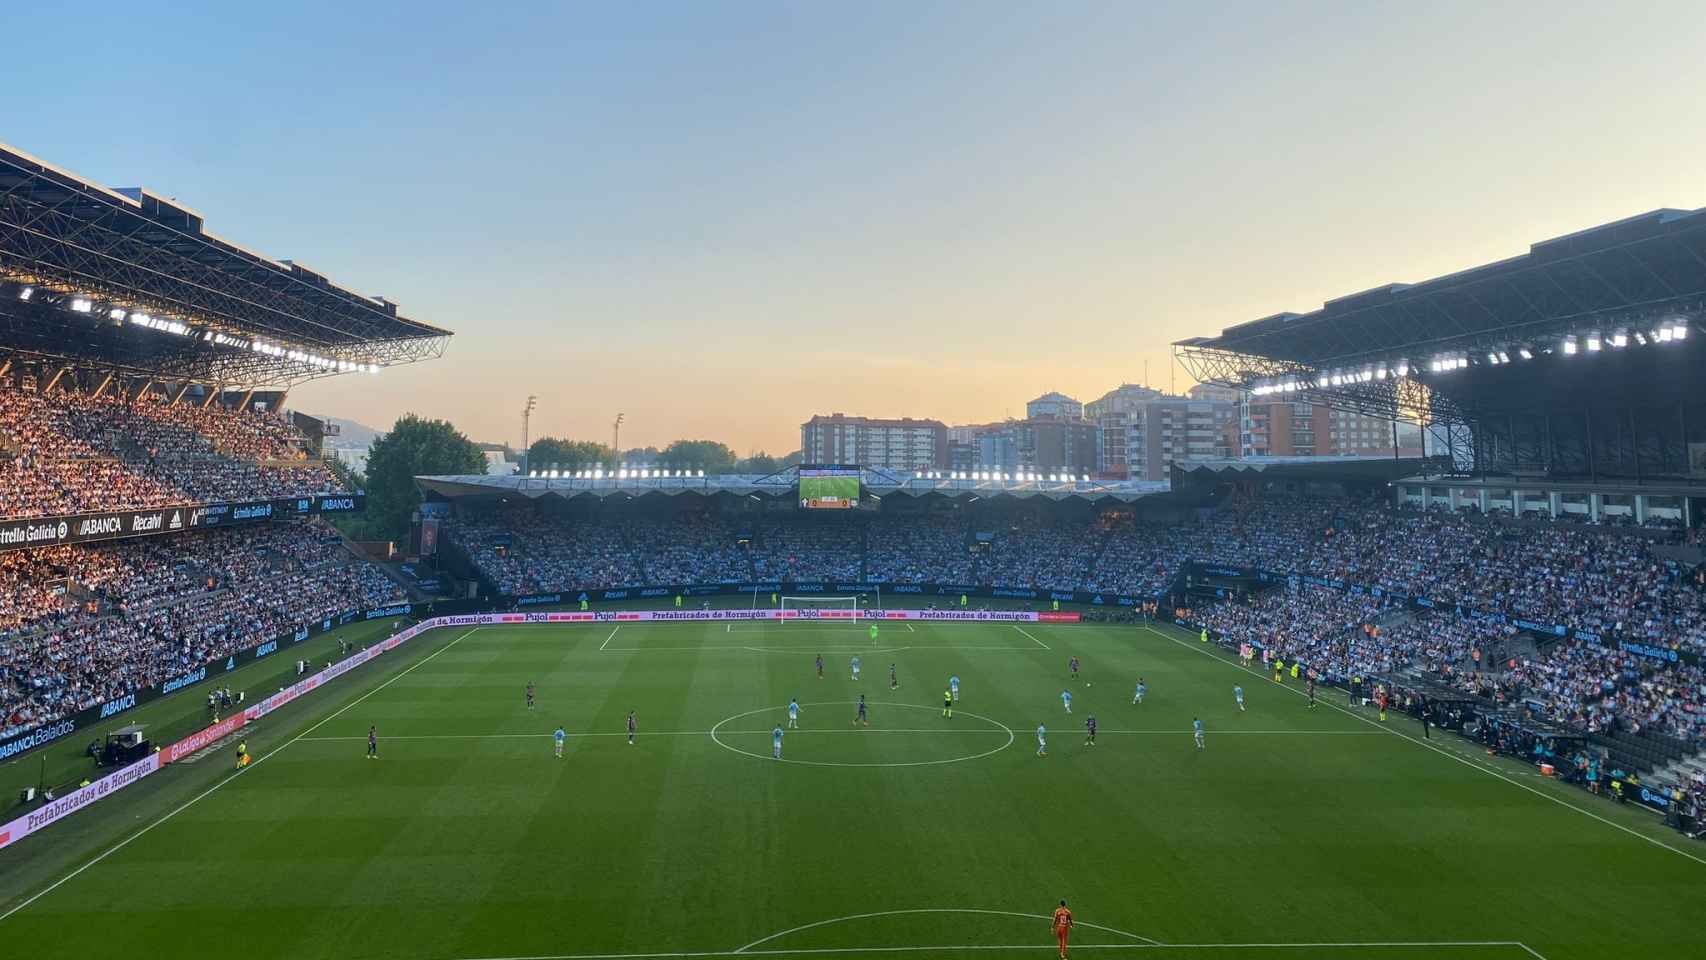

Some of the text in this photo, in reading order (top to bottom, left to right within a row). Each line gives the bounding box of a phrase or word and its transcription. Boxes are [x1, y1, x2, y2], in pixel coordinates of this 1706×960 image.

[321, 498, 354, 510] ABANCA
[80, 517, 121, 535] ABANCA
[133, 513, 162, 531] Recalvi
[0, 524, 56, 544] trella Galicia
[526, 612, 548, 623] Pujol
[594, 611, 617, 622] Pujol
[652, 610, 767, 620] Prefabricados de Hormigón
[798, 609, 819, 619] Pujol
[864, 609, 886, 619] Pujol
[977, 611, 988, 620] de
[162, 669, 200, 694] Estrella Galicia
[100, 694, 136, 719] ABANCA
[0, 719, 75, 759] ABANCA Balaídos
[27, 761, 152, 831] Prefabricados de Hormigón
